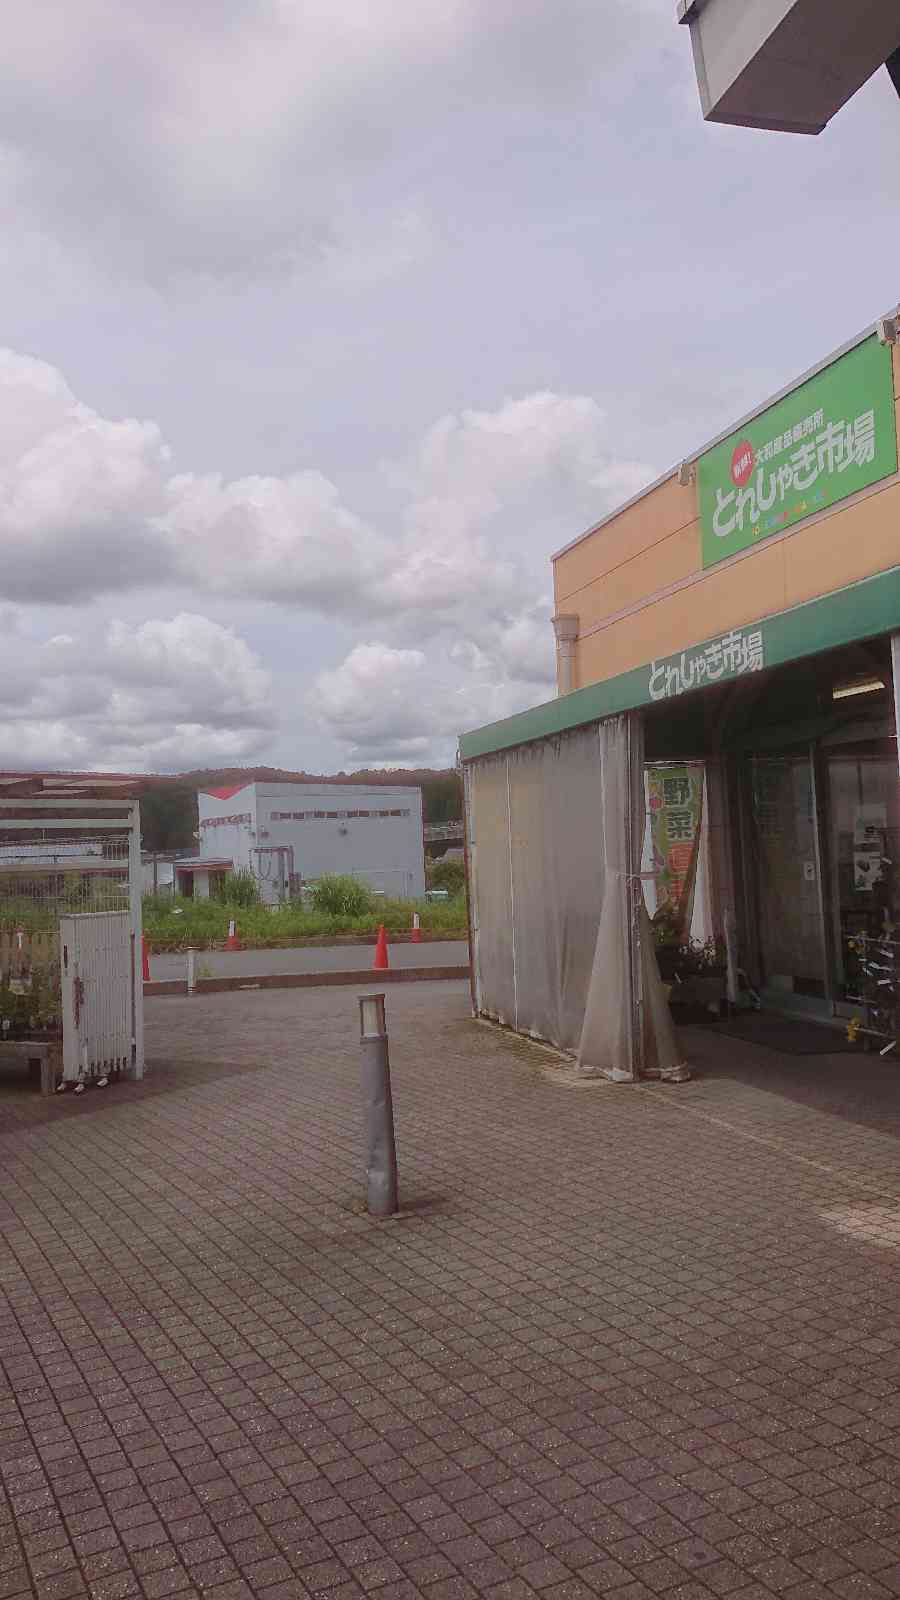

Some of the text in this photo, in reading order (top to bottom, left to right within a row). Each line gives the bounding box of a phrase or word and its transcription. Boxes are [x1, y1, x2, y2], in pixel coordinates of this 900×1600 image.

[712, 409, 875, 537] とれしゃき市場
[648, 630, 764, 700] とれしゃき市場
[662, 776, 694, 840] 野菜
